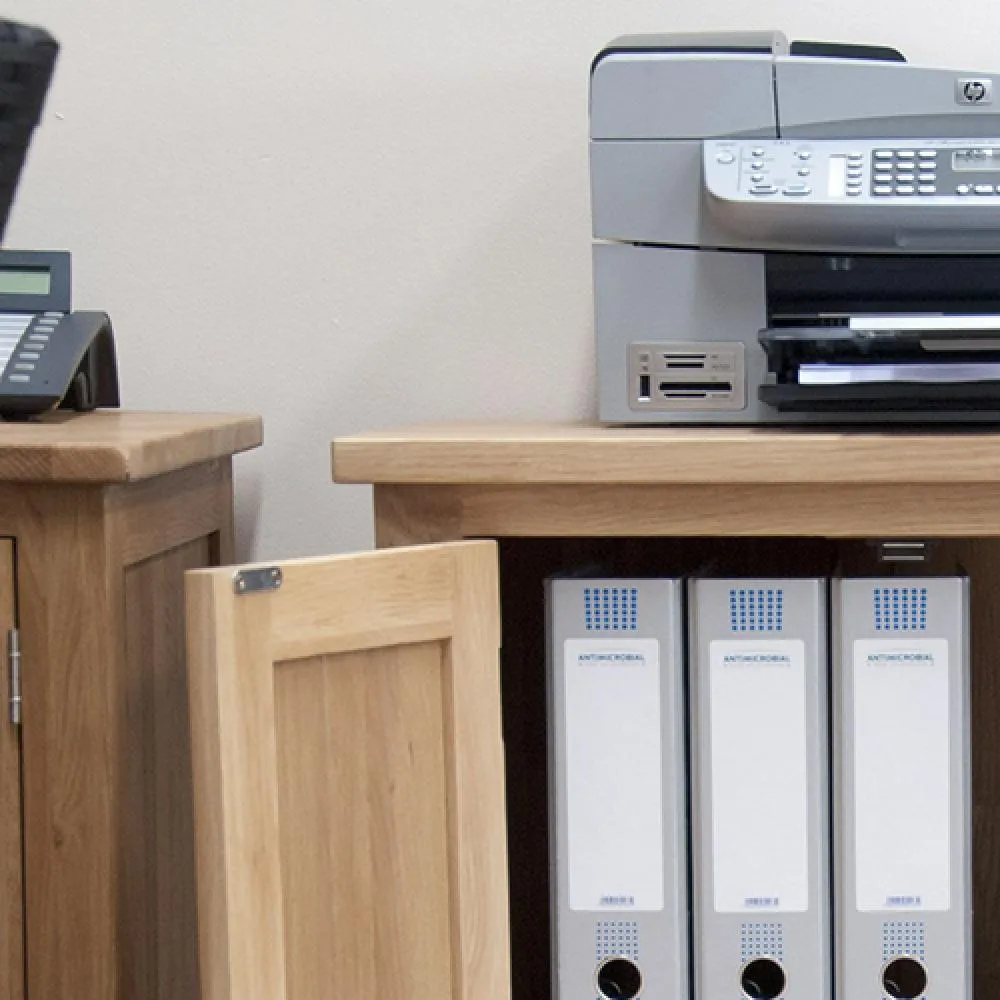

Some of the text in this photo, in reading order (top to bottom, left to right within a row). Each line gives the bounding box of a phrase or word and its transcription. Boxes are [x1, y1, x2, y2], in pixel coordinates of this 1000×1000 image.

[578, 653, 645, 661] ANTIMICROBIAL
[723, 655, 790, 663] ANTIMICROBIAL
[867, 653, 934, 661] ANTIMICROBIAL
